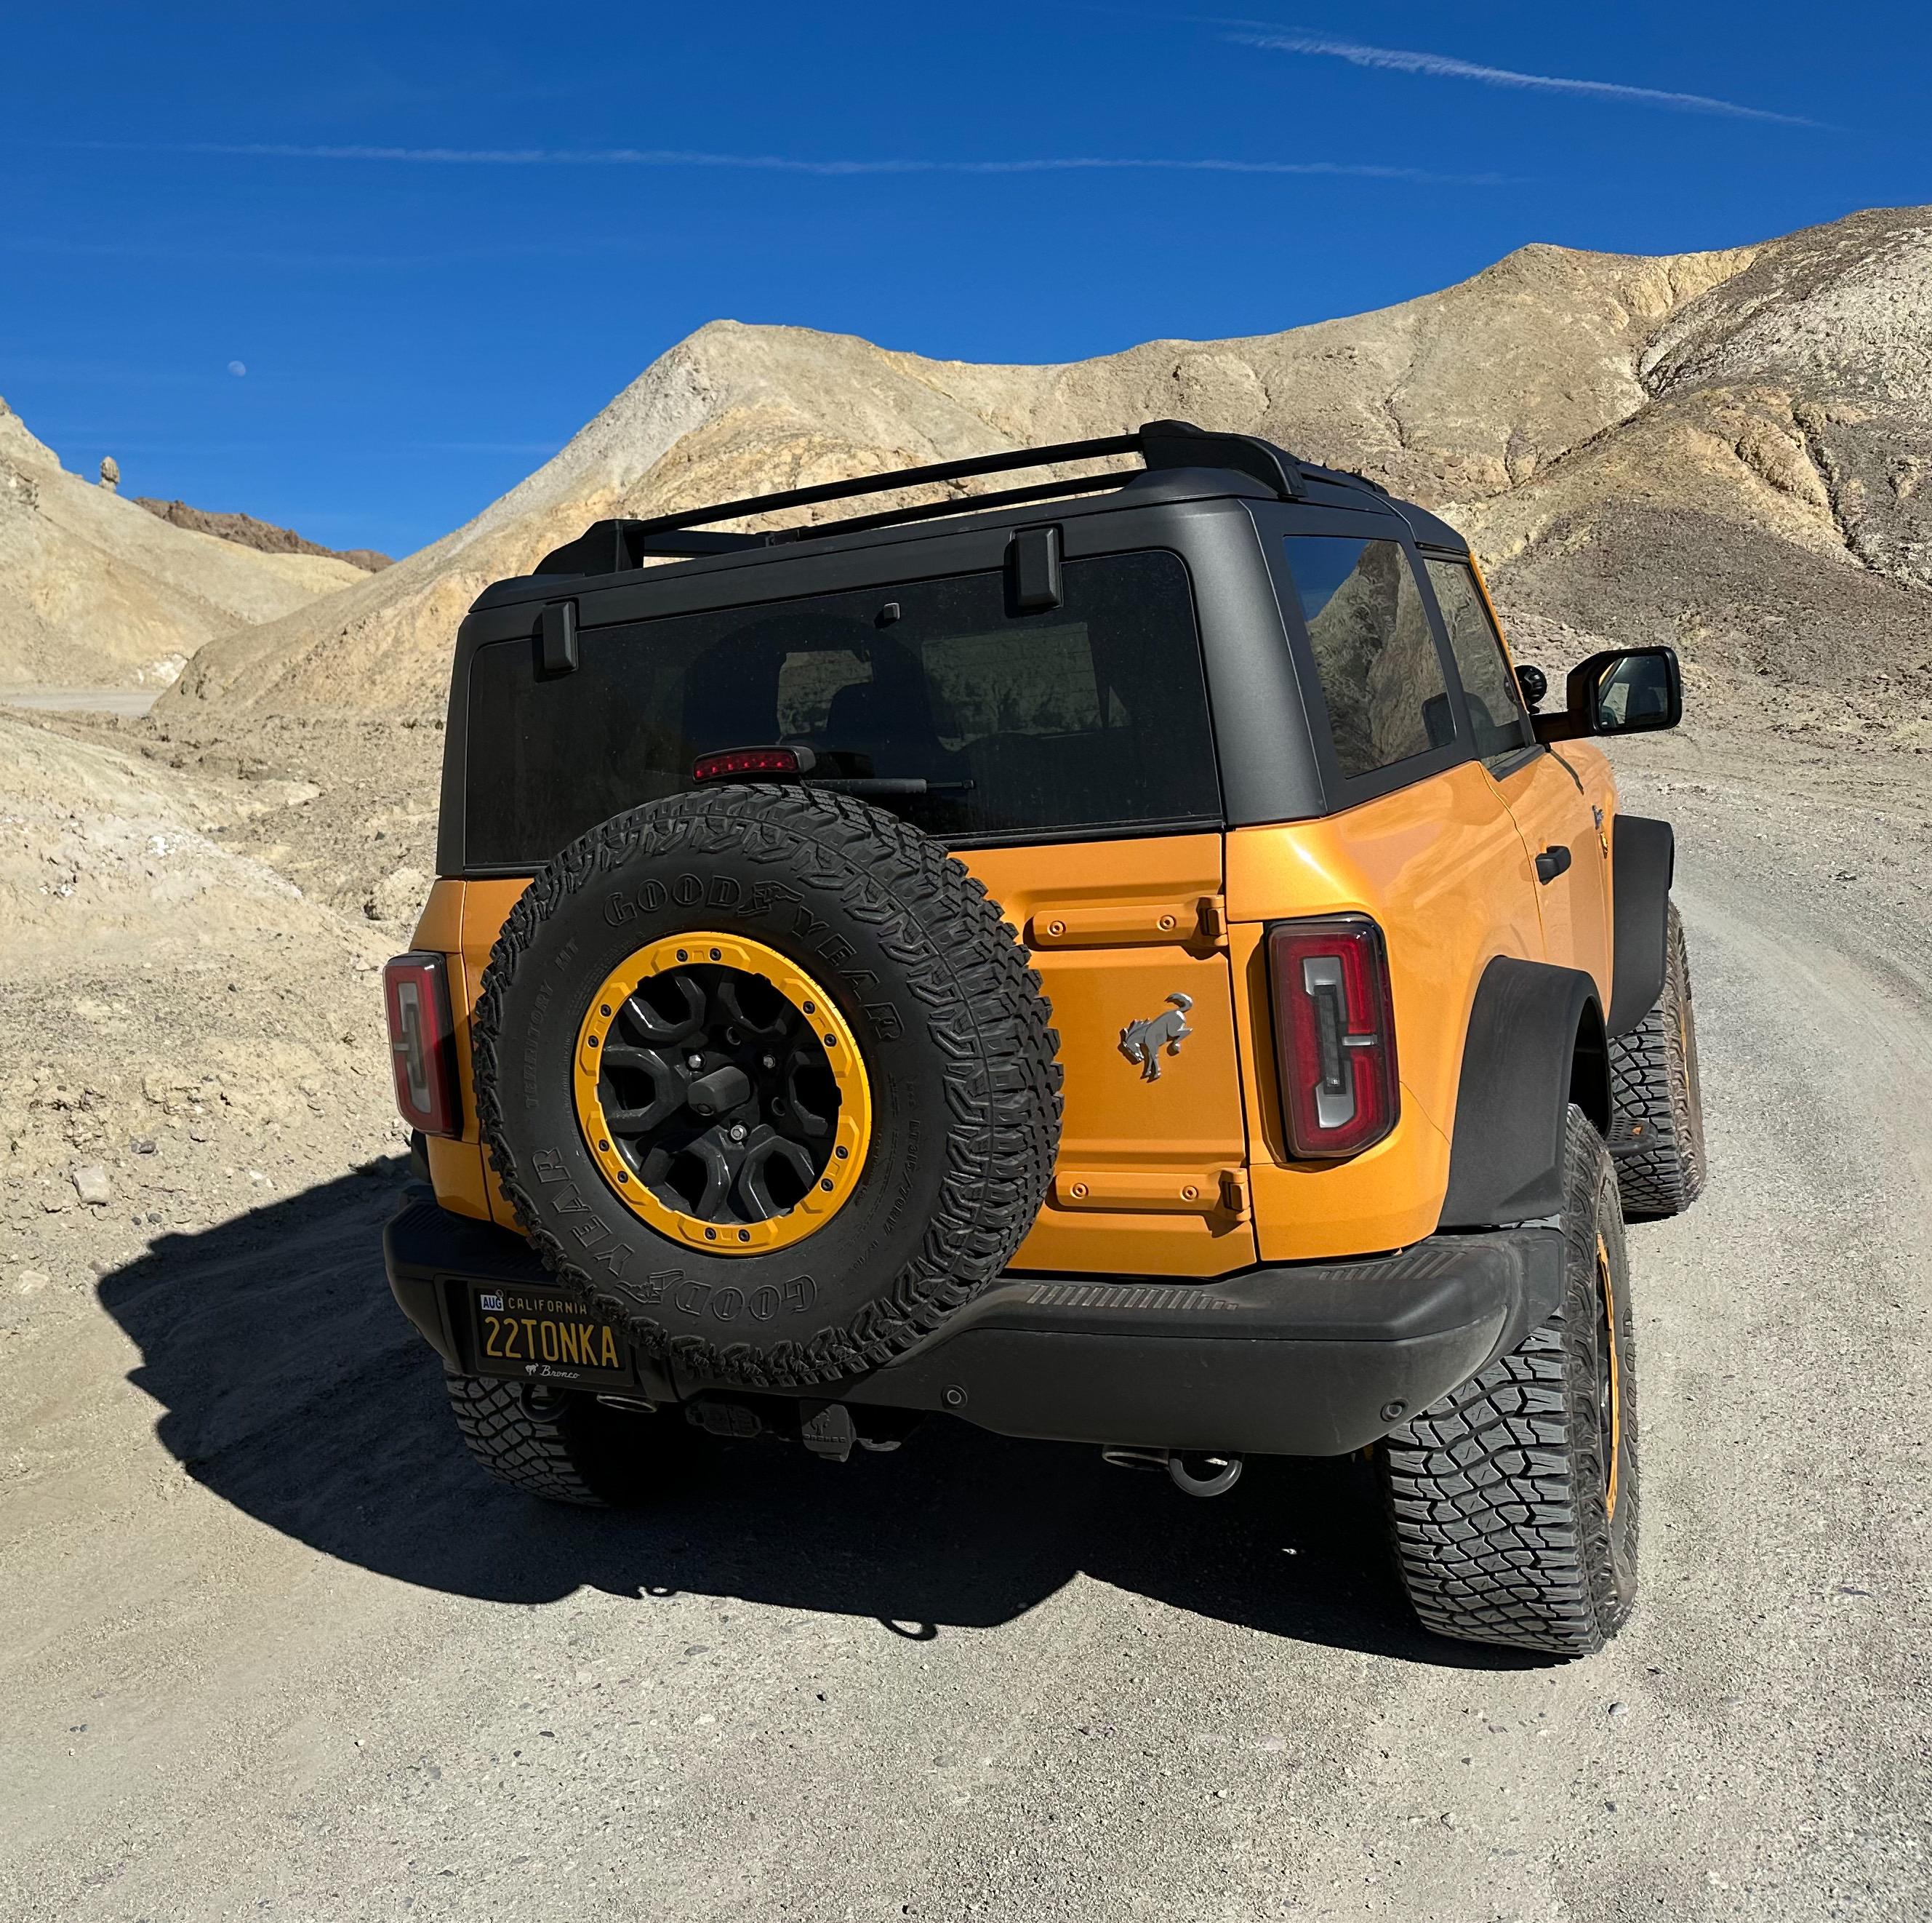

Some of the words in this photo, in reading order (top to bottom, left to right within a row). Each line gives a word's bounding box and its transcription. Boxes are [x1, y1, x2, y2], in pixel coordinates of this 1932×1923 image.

[524, 978, 553, 1110] TERRITORY
[483, 1296, 502, 1309] AUG
[508, 1297, 588, 1315] CALIFORNIA
[484, 1316, 619, 1368] 22TONKA
[540, 1364, 581, 1379] Bronco
